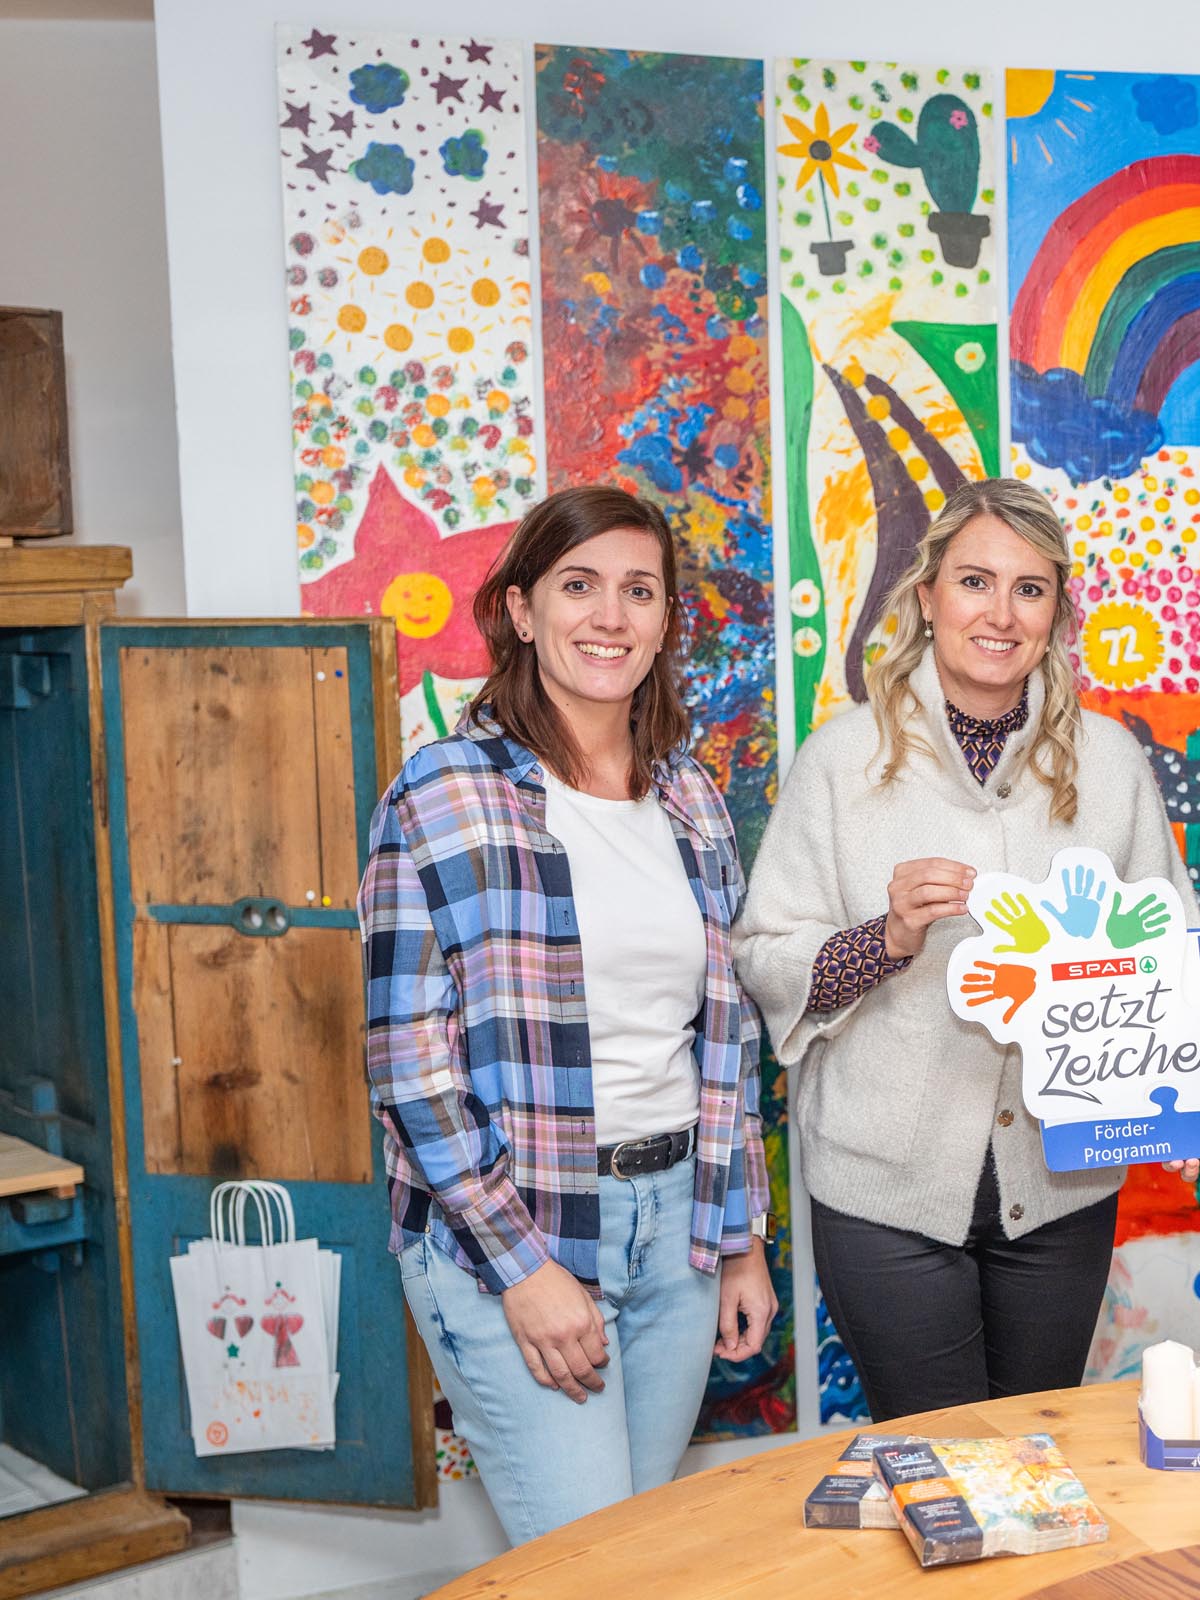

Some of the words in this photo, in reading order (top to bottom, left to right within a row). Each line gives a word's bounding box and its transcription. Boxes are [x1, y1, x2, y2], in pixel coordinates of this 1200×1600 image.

[1068, 960, 1135, 977] SPAR
[1041, 978, 1173, 1039] setzt
[1094, 1121, 1156, 1141] Förder-
[1083, 1141, 1172, 1164] Programm
[1191, 1459, 1198, 1468] 4
